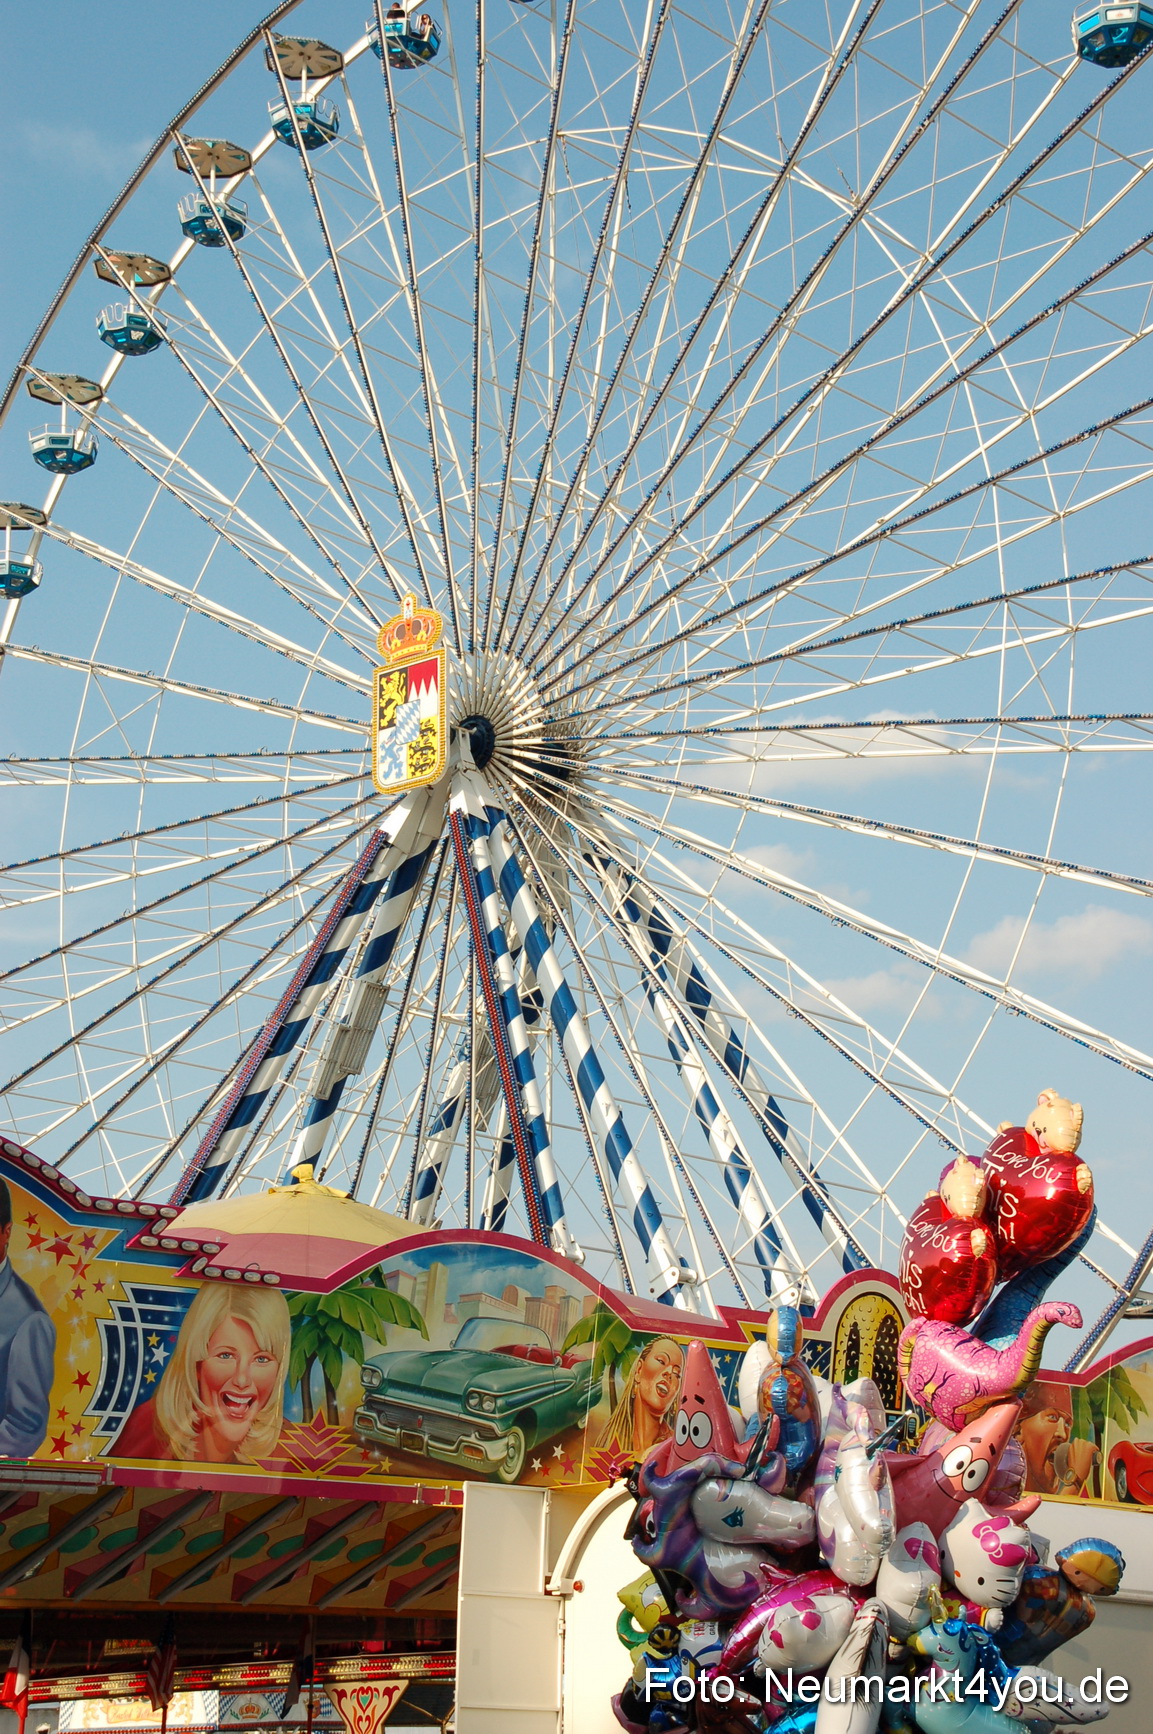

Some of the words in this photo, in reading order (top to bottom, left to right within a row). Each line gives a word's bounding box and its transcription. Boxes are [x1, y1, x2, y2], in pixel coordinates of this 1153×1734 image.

[992, 1138, 1028, 1168] Love
[1018, 1156, 1063, 1184] You
[921, 1224, 957, 1252] You
